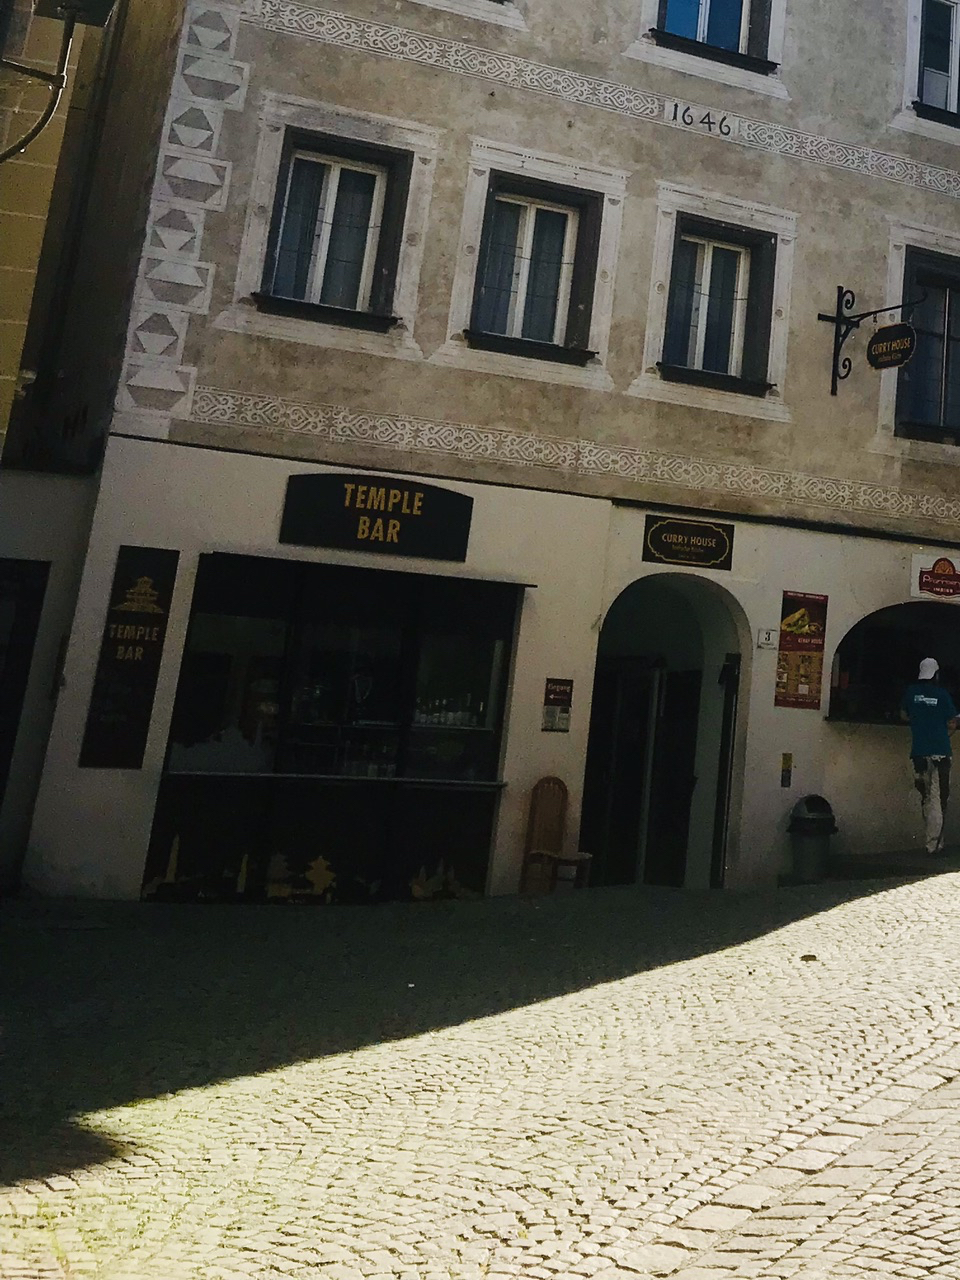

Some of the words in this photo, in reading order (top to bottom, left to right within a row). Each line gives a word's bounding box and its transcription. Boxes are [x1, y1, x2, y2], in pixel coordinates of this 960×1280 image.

[672, 102, 731, 136] 1646
[871, 341, 891, 355] CURRY
[891, 337, 911, 351] HOUSE
[344, 483, 424, 515] TEMPLE
[357, 516, 401, 543] BAR
[661, 533, 688, 544] CURRY
[690, 536, 717, 548] HOUSE
[109, 623, 160, 642] TEMPLE
[765, 632, 771, 641] 3
[115, 646, 145, 661] BAR
